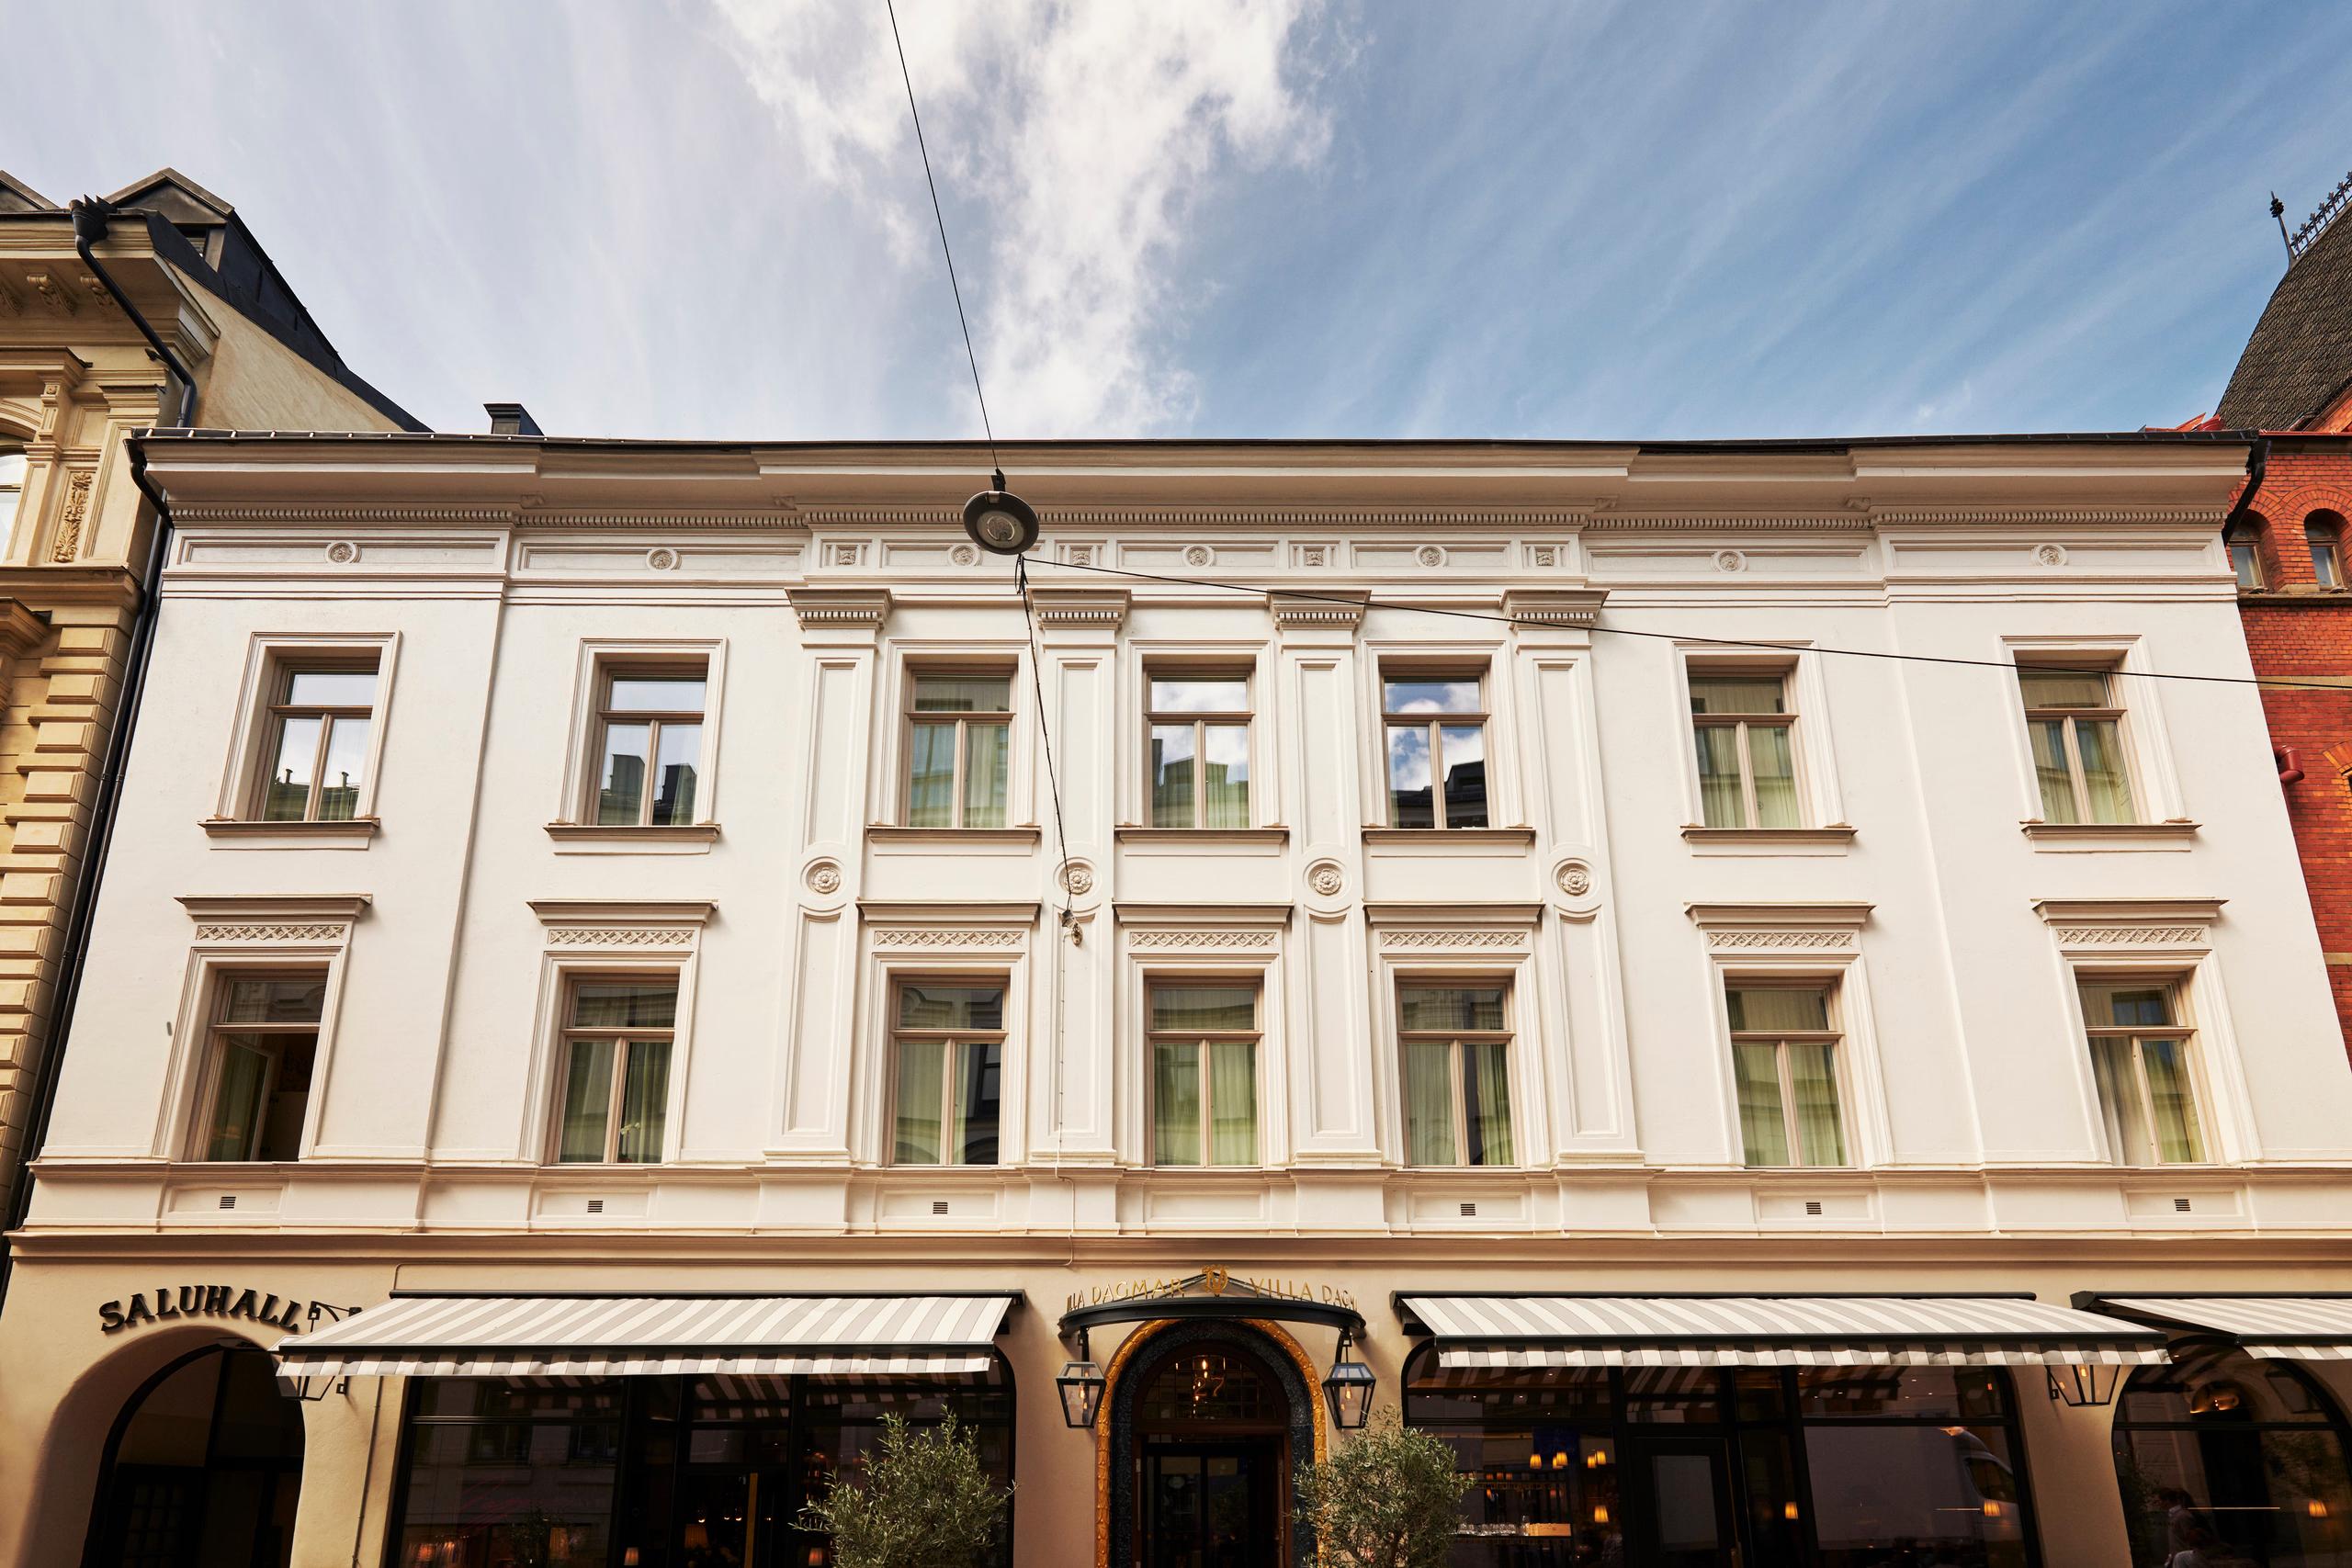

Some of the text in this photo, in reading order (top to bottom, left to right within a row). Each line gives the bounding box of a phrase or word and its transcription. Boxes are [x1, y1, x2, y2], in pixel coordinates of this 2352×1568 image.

[1091, 1278, 1185, 1303] DAGMAR
[1250, 1278, 1313, 1301] VILLA
[98, 1284, 302, 1333] SALUHALL
[1193, 1376, 1226, 1397] 27
